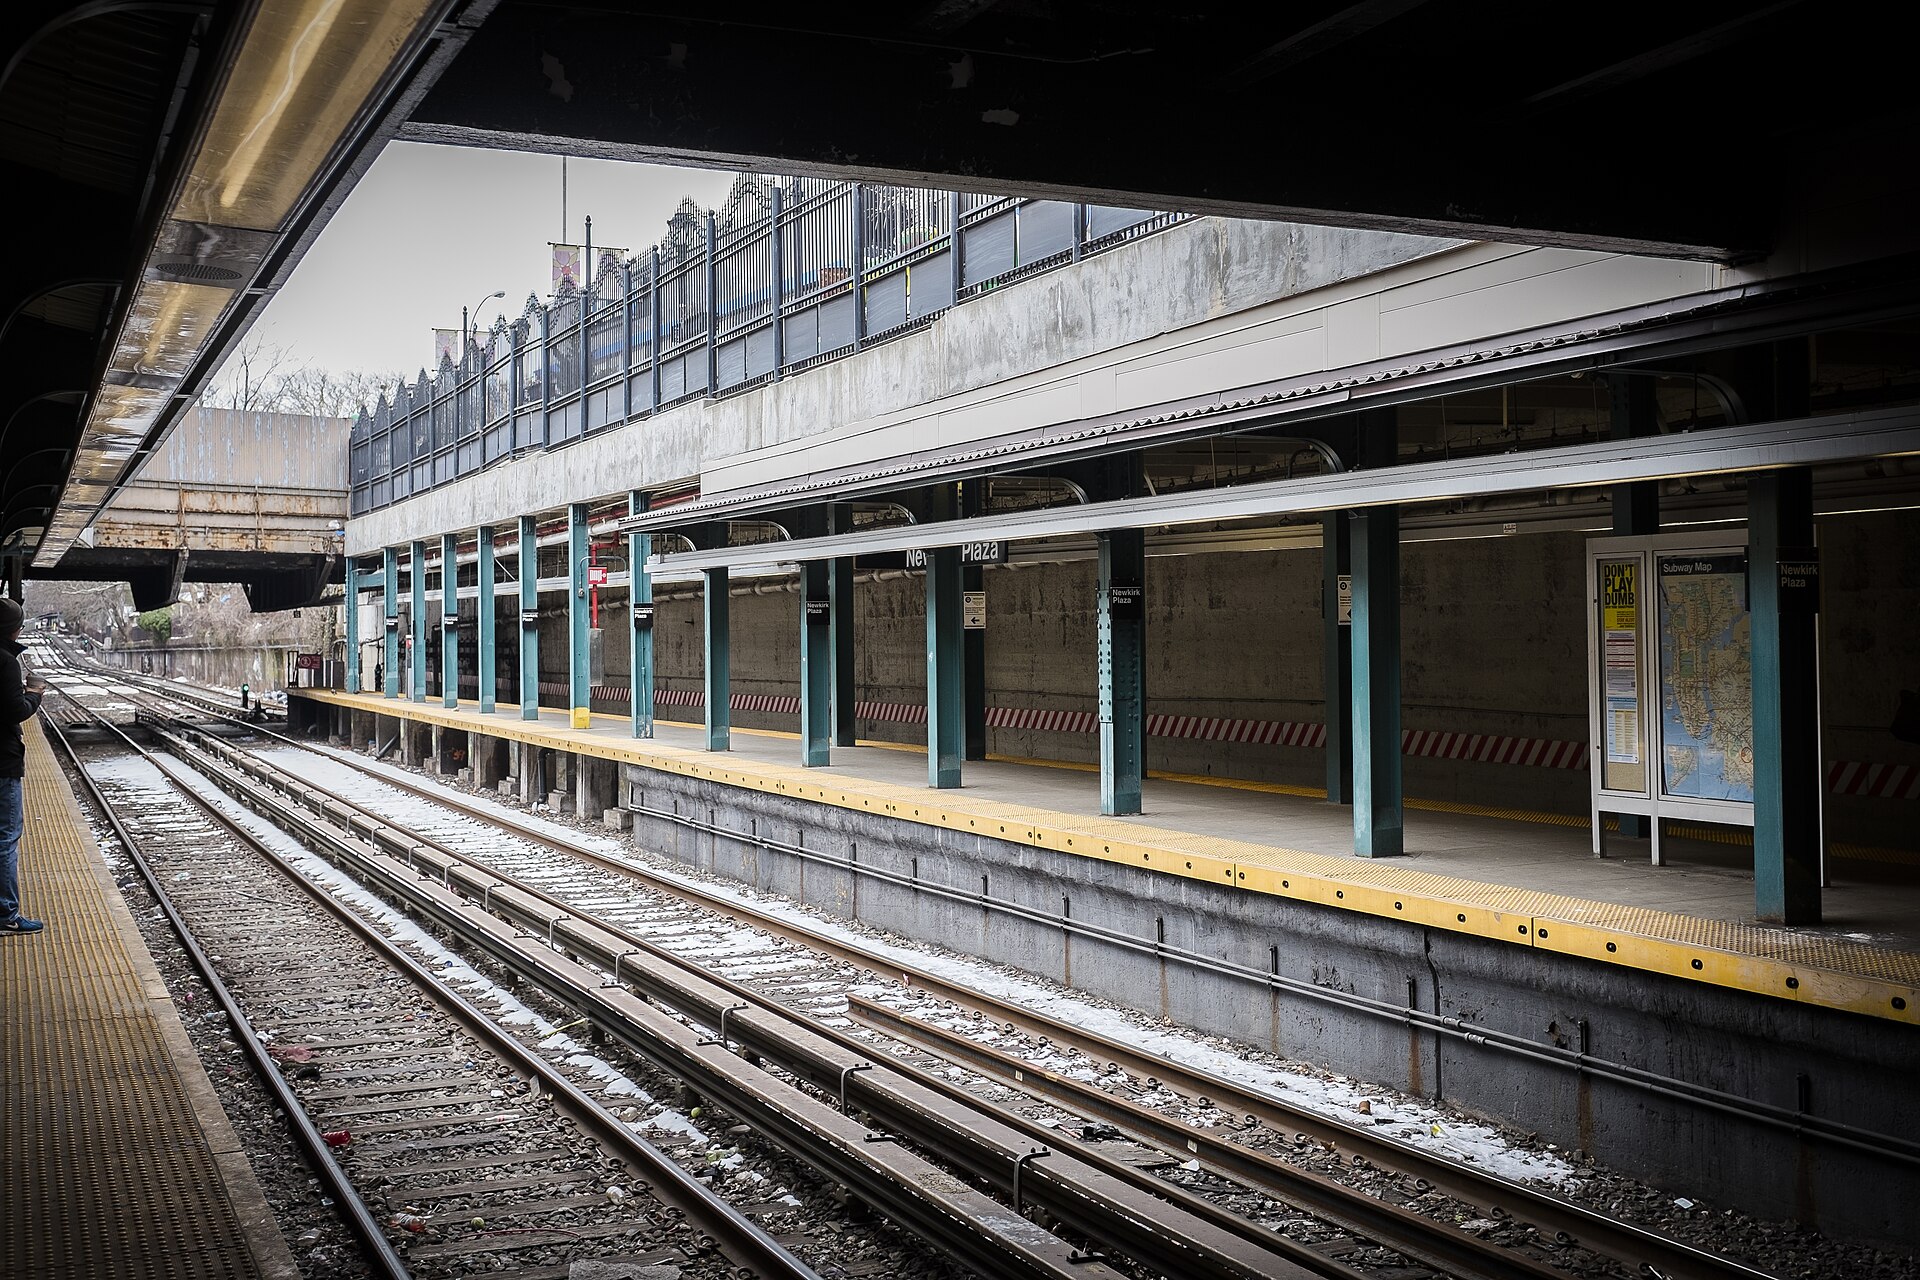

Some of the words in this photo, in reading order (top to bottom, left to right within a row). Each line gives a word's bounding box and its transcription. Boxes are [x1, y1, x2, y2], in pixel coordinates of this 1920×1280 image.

[961, 541, 999, 562] Plaza
[1604, 564, 1634, 577] DON'T
[1663, 563, 1693, 574] Subway
[1694, 562, 1712, 573] Map
[1780, 564, 1818, 575] Newkirk
[1604, 577, 1634, 592] PLAY
[1780, 577, 1806, 588] Plaza
[1604, 592, 1635, 605] DUMB
